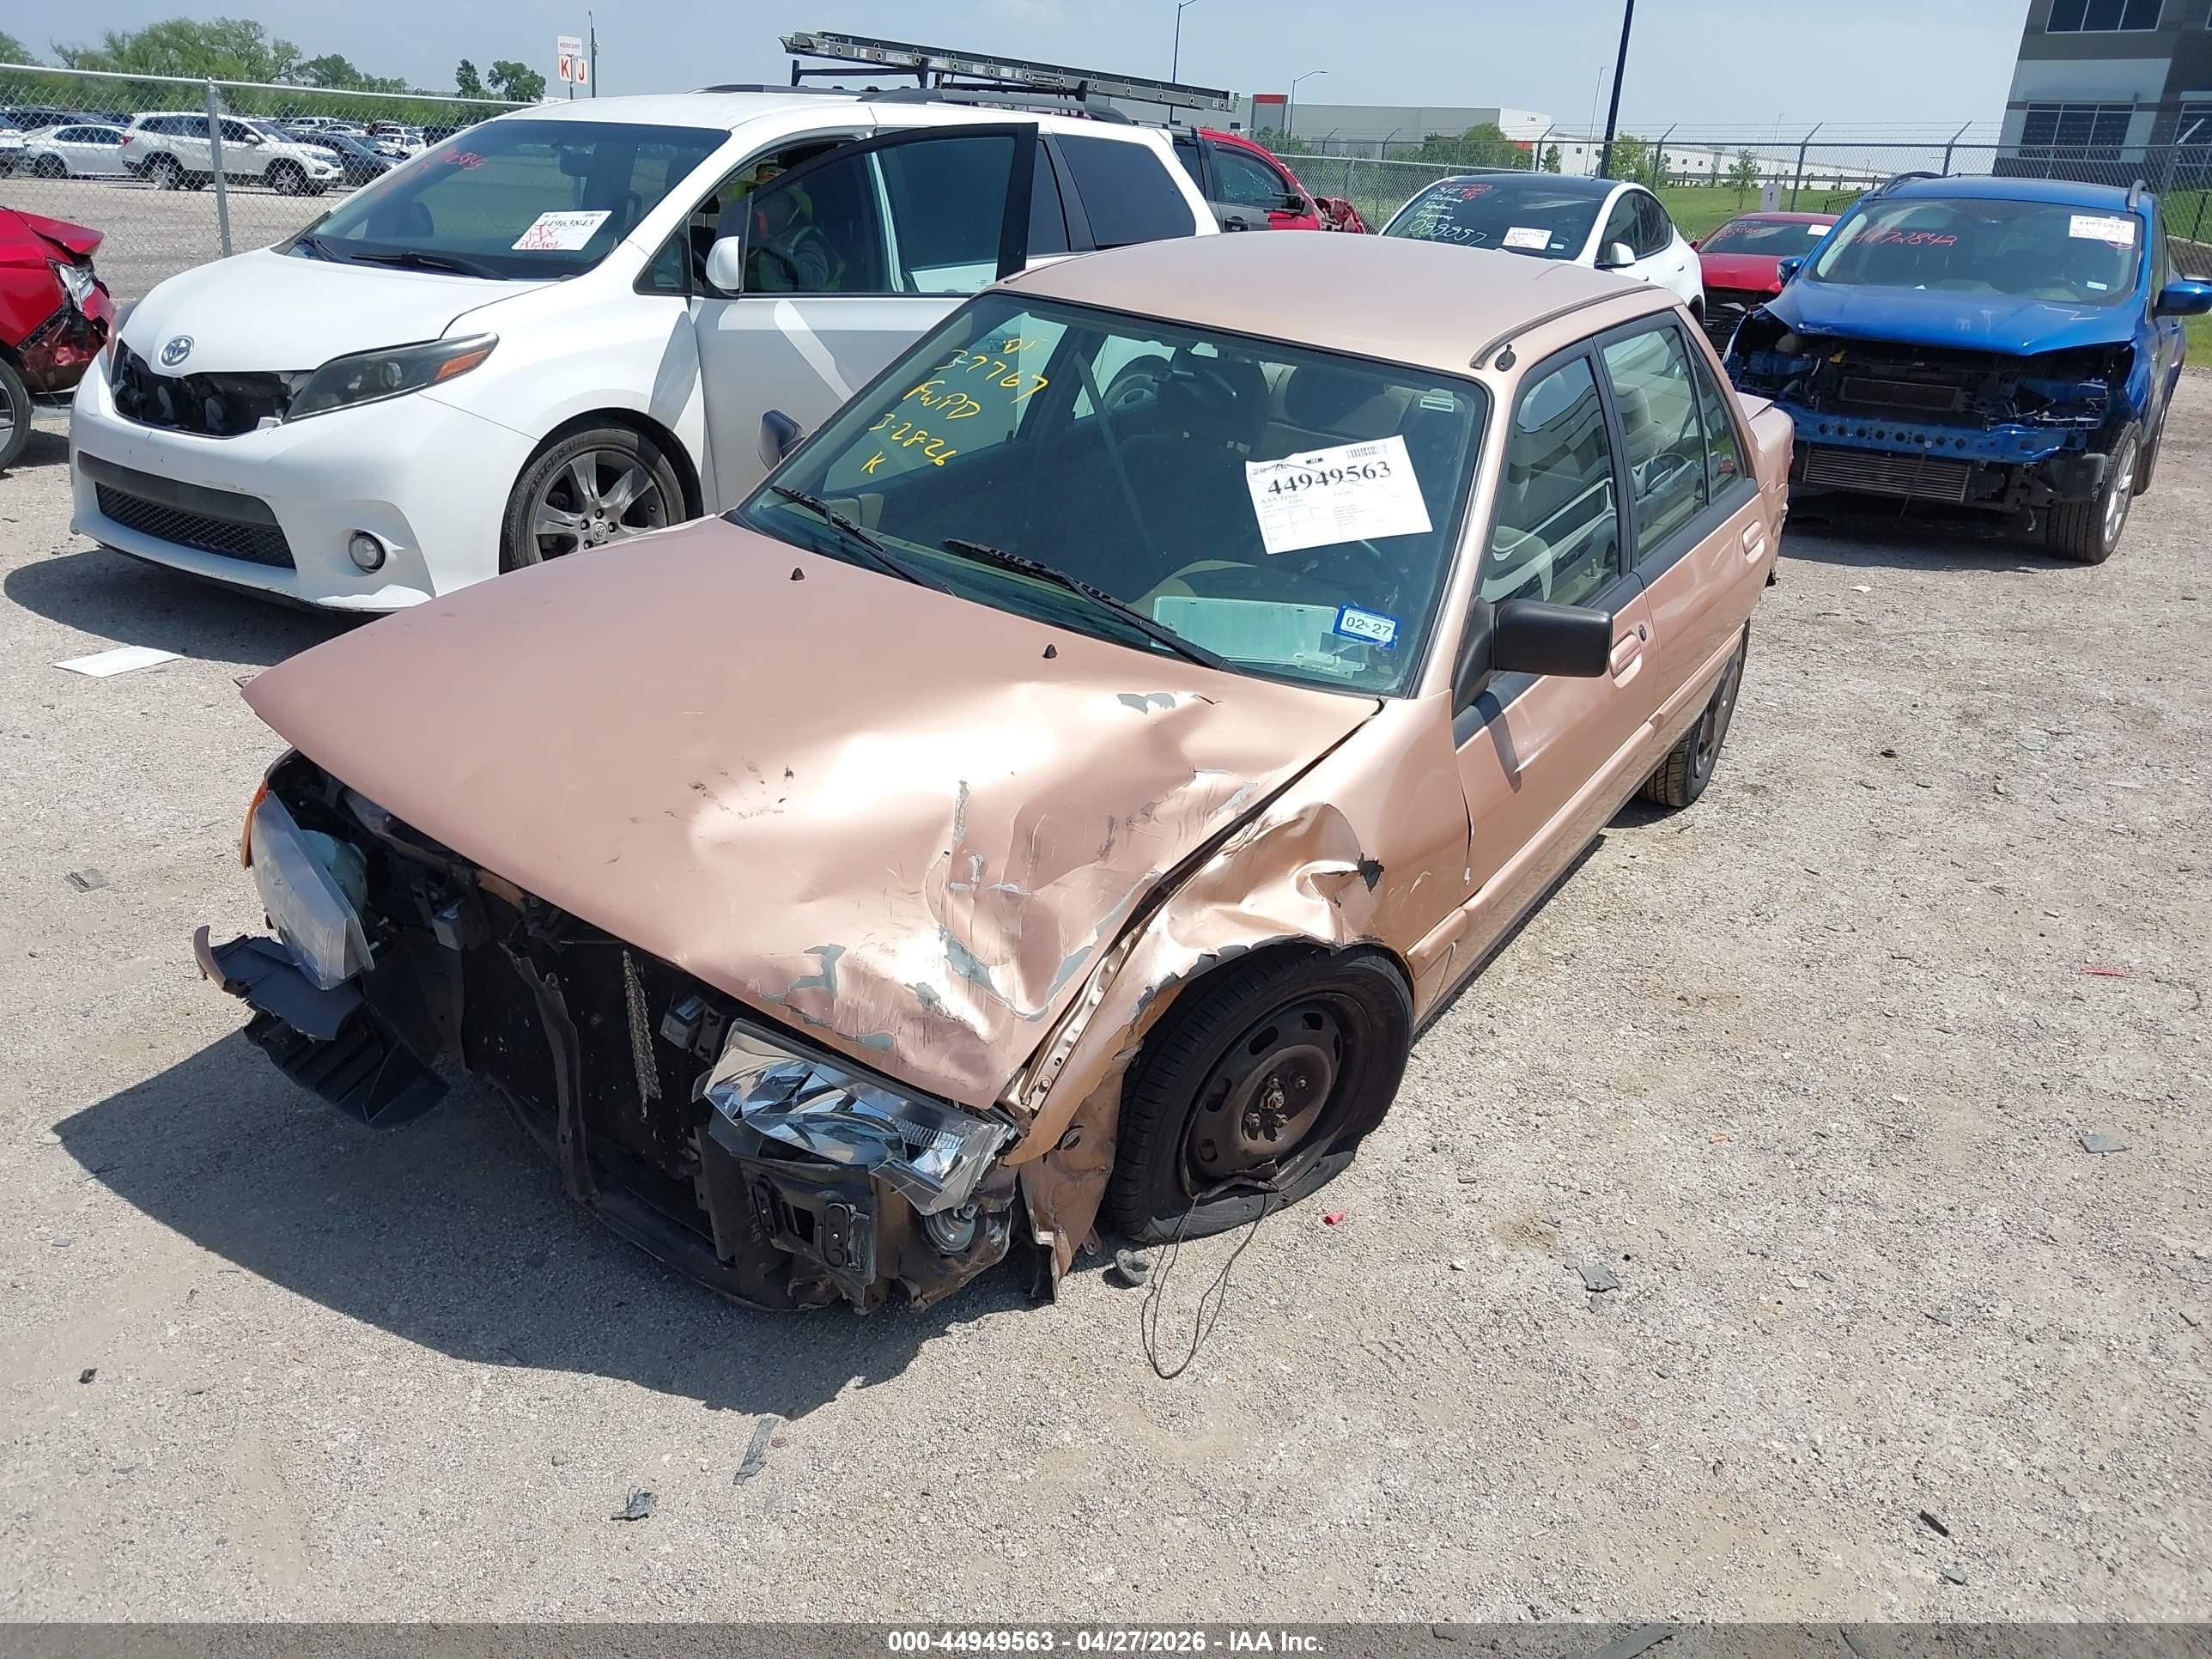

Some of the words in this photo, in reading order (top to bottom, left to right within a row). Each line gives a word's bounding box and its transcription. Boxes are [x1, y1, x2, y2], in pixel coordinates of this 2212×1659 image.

[561, 58, 570, 78] K
[579, 63, 585, 81] J
[1267, 460, 1392, 495] 44949563
